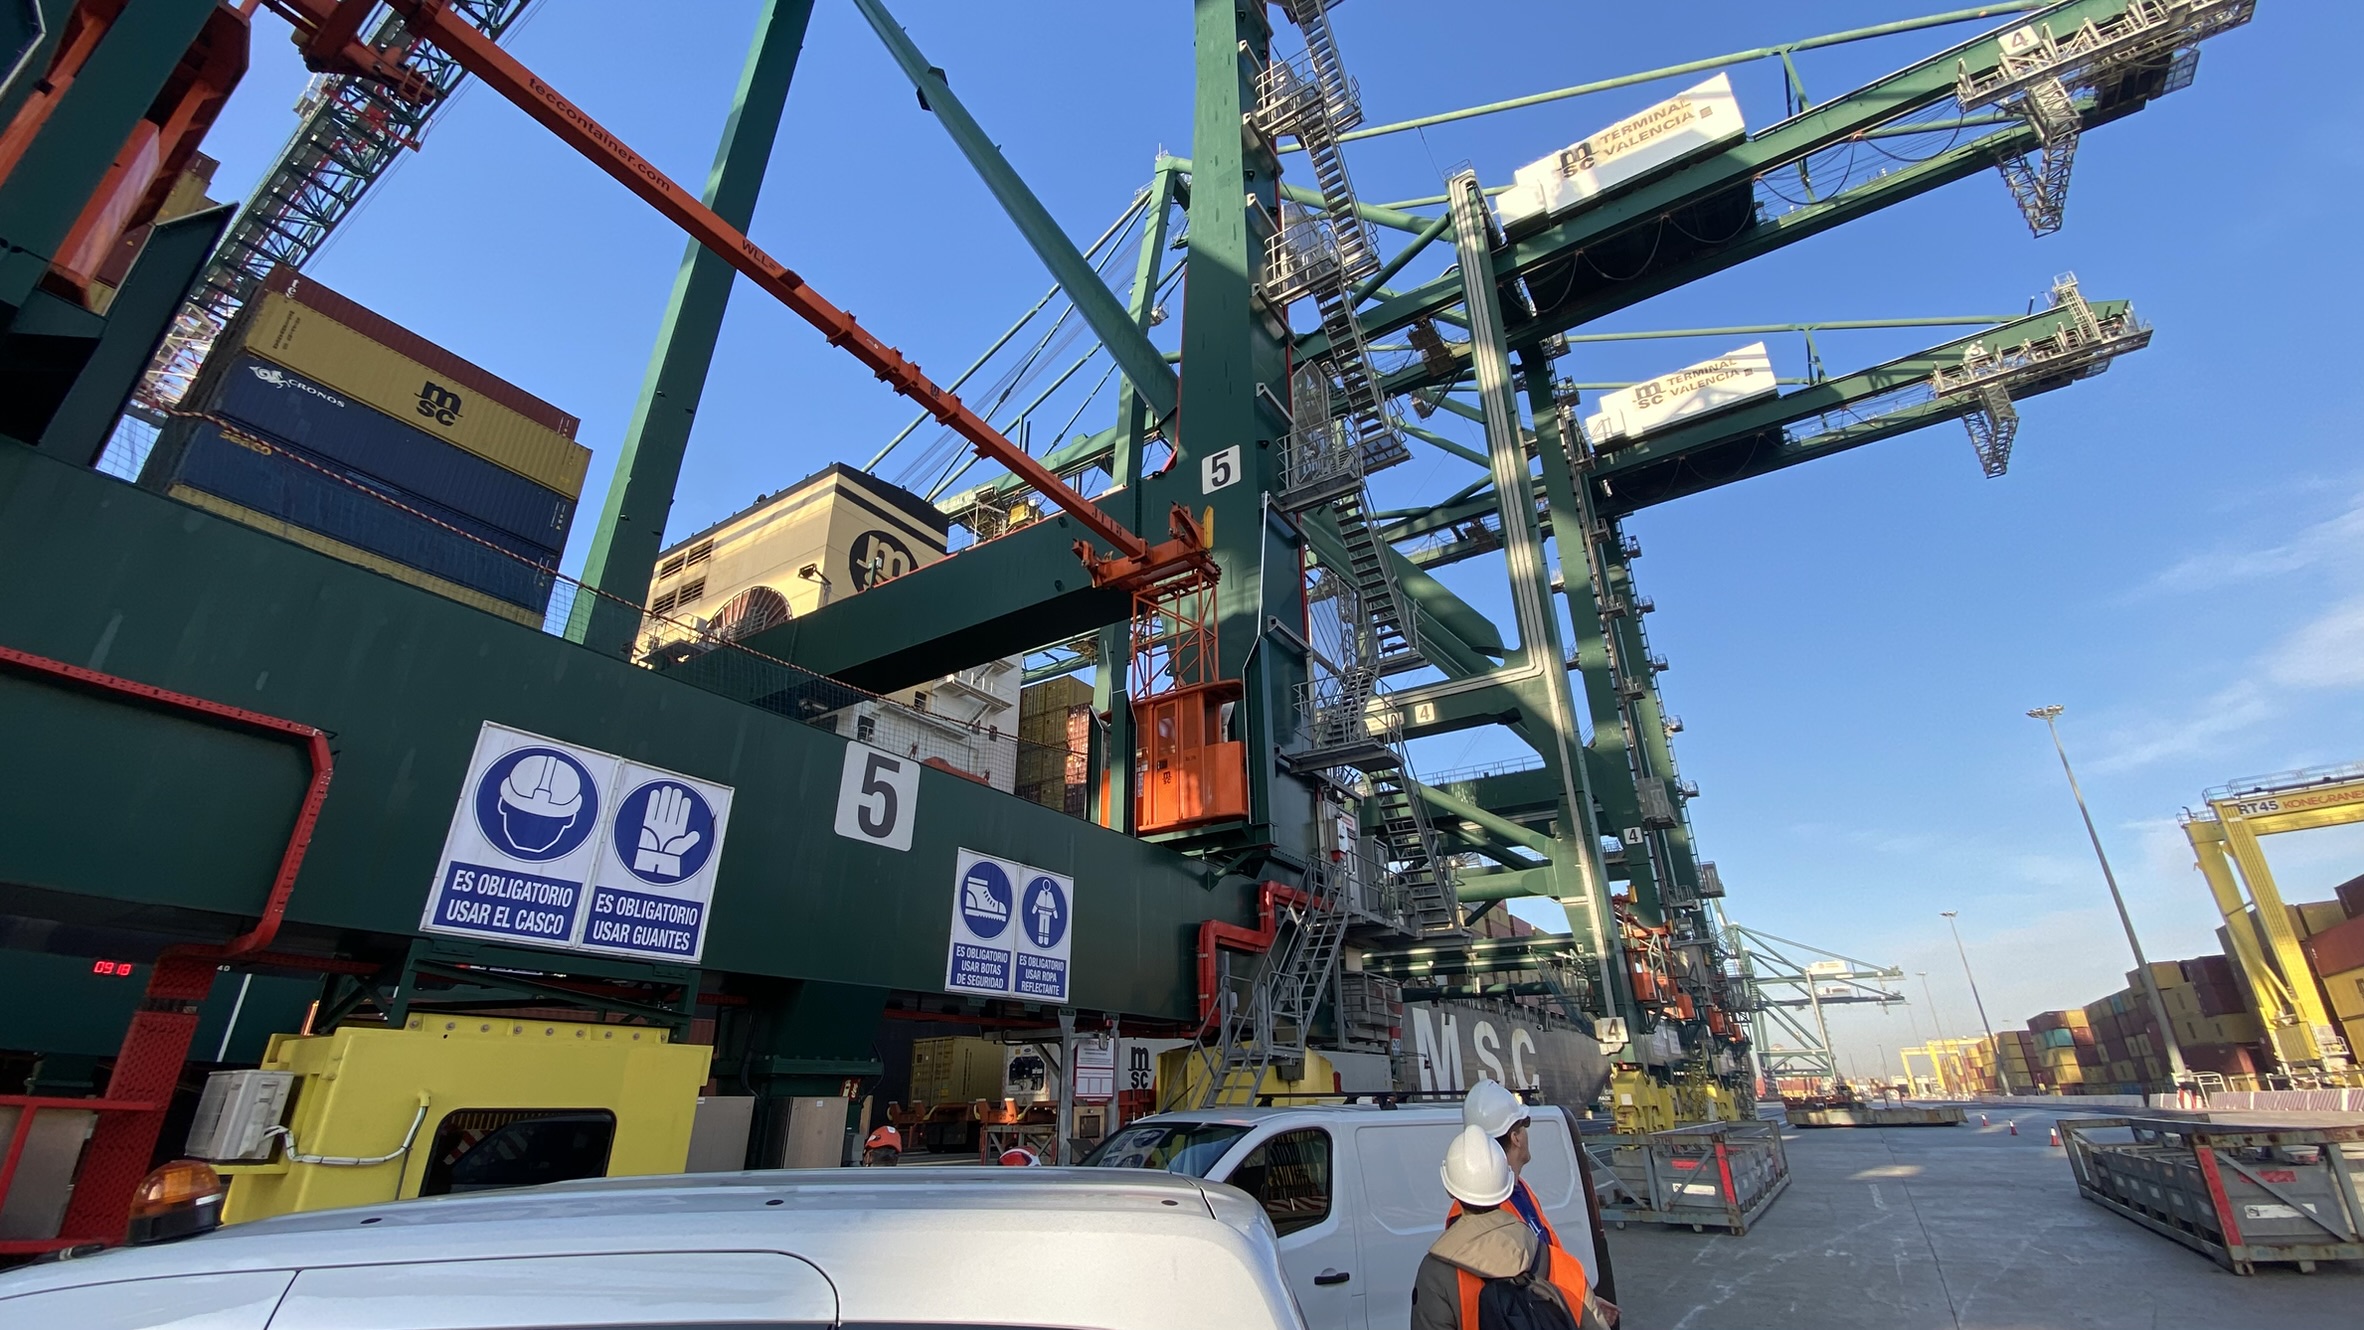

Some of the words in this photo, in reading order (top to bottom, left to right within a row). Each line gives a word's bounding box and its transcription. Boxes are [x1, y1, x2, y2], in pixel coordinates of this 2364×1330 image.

[2012, 31, 2028, 48] 4
[1600, 99, 1691, 144] TERMINAL
[1601, 111, 1695, 156] VALENCIA
[529, 77, 670, 192] teccontainer.com
[1666, 358, 1737, 386] TERMINAL
[1669, 368, 1740, 397] VALENCIA
[288, 378, 345, 408] CRONOS
[1211, 450, 1231, 487] 5
[1419, 705, 1430, 720] 4
[858, 751, 900, 838] 5
[2239, 800, 2279, 815] RT45
[1628, 828, 1638, 842] 4
[452, 869, 473, 893] ES
[477, 873, 573, 908] OBLIGATORIO
[446, 899, 490, 925] USAR
[493, 906, 511, 928] EL
[515, 909, 564, 935] CASCO
[595, 893, 614, 914] ES
[616, 896, 698, 926] OBLIGATORIO
[592, 920, 629, 943] USAR
[633, 926, 691, 951] GUANTES
[956, 945, 966, 957] ES
[966, 947, 1009, 963] OBLIGATORIO
[1019, 955, 1028, 966] ES
[1028, 957, 1065, 972] OBLIGATORIO
[217, 964, 231, 972] 40
[961, 960, 980, 973] USAR
[981, 962, 1002, 976] BOTAS
[1025, 969, 1041, 980] USAR
[1042, 970, 1057, 983] ROPA
[956, 973, 967, 985] DE
[967, 974, 1004, 989] SEGURIDAD
[1021, 981, 1060, 996] REFLECTANTE
[1608, 1018, 1621, 1041] 4
